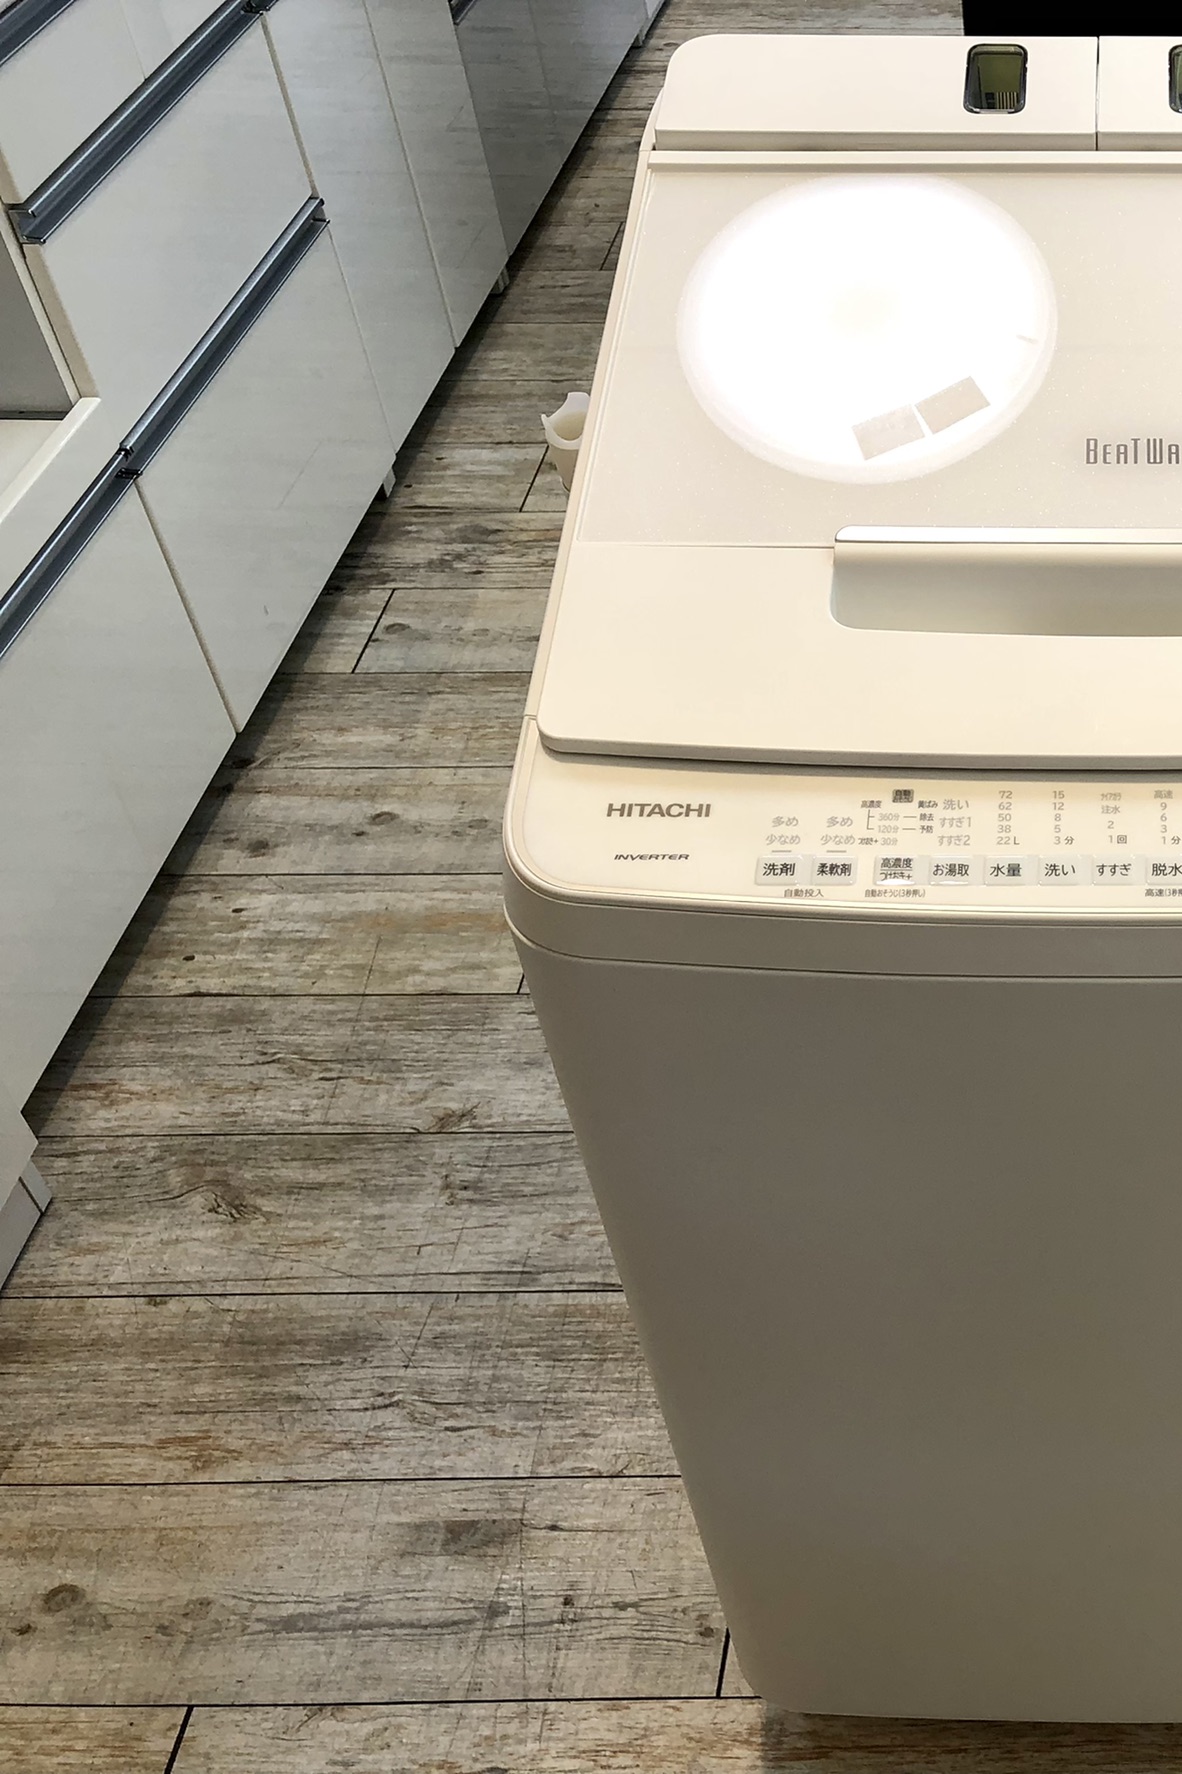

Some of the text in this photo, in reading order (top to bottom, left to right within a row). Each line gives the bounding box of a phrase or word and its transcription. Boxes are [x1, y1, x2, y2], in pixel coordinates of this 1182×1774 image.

[998, 790, 1013, 799] 72
[1052, 790, 1065, 799] 15
[1153, 790, 1173, 799] 高速
[942, 799, 969, 810] 洗い
[998, 802, 1012, 811] 62
[1052, 802, 1065, 811] 12
[1160, 802, 1167, 811] 9
[606, 803, 711, 818] HITACHI
[1101, 805, 1121, 814] 注水
[771, 816, 799, 827] 多め
[878, 813, 900, 822] 360分
[919, 813, 934, 821] 除去
[998, 813, 1012, 822] 50
[1054, 813, 1062, 822] 8
[1160, 813, 1167, 822] 6
[826, 816, 853, 828] 多め
[1107, 820, 1114, 829] 2
[877, 825, 899, 834] 120分
[919, 825, 934, 834] 予防
[997, 824, 1011, 833] 38
[1054, 824, 1061, 833] 5
[1160, 824, 1167, 833] 3
[765, 834, 801, 845] 少なめ
[820, 834, 856, 846] 少なめ
[996, 836, 1020, 845] 22 L
[1053, 836, 1075, 845] 3 分
[1116, 834, 1127, 844] 回
[1170, 835, 1182, 845] 分
[613, 853, 690, 861] INVERTER
[880, 857, 914, 868] 高濃度
[762, 863, 796, 876] 洗剤
[817, 863, 852, 876] 柔軟剤
[932, 863, 970, 877] お湯取
[989, 863, 1022, 877] 水量
[1044, 863, 1076, 877] 洗い
[1096, 863, 1132, 877] すすぎ
[784, 888, 825, 898] 自動投入
